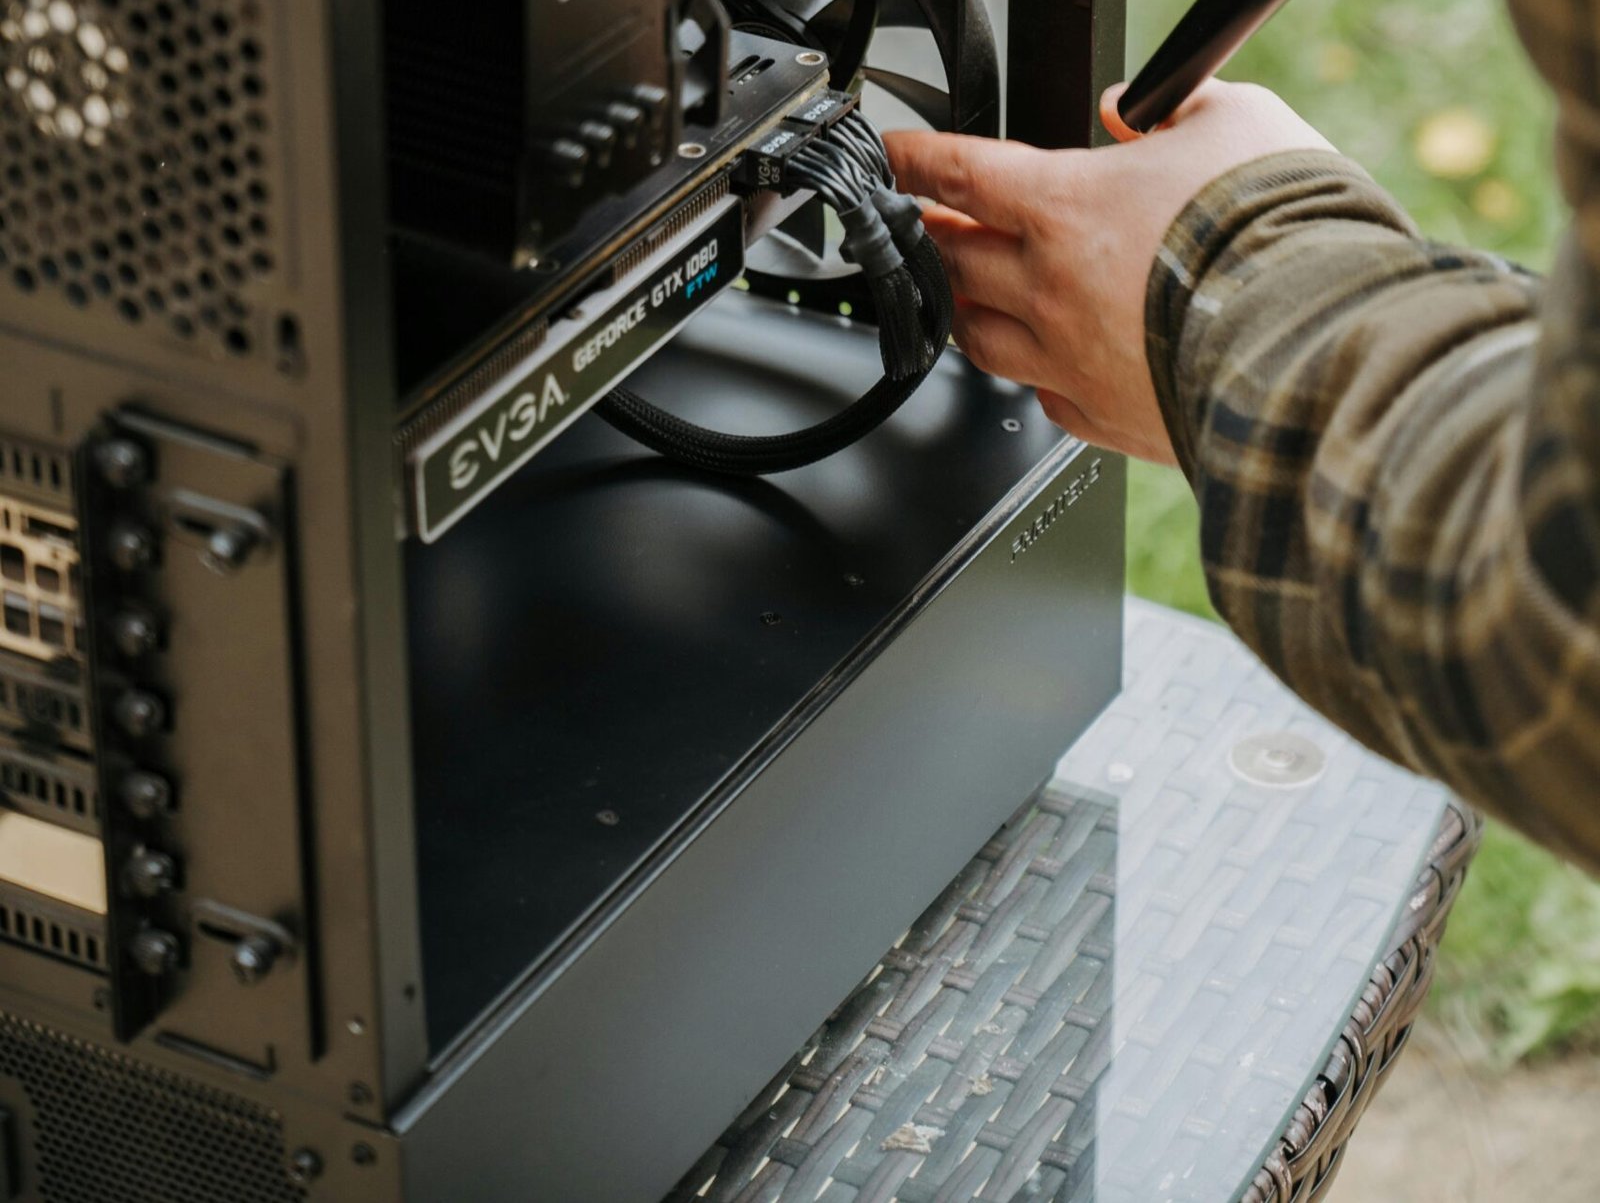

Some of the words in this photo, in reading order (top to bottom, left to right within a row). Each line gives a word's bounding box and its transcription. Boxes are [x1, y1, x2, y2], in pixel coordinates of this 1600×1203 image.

[758, 157, 771, 185] VGA
[771, 165, 780, 183] GS
[685, 261, 719, 300] FTW
[449, 373, 565, 490] EVGA
[572, 298, 648, 373] GEFORCE
[651, 266, 684, 308] GTX
[685, 238, 718, 281] 1080
